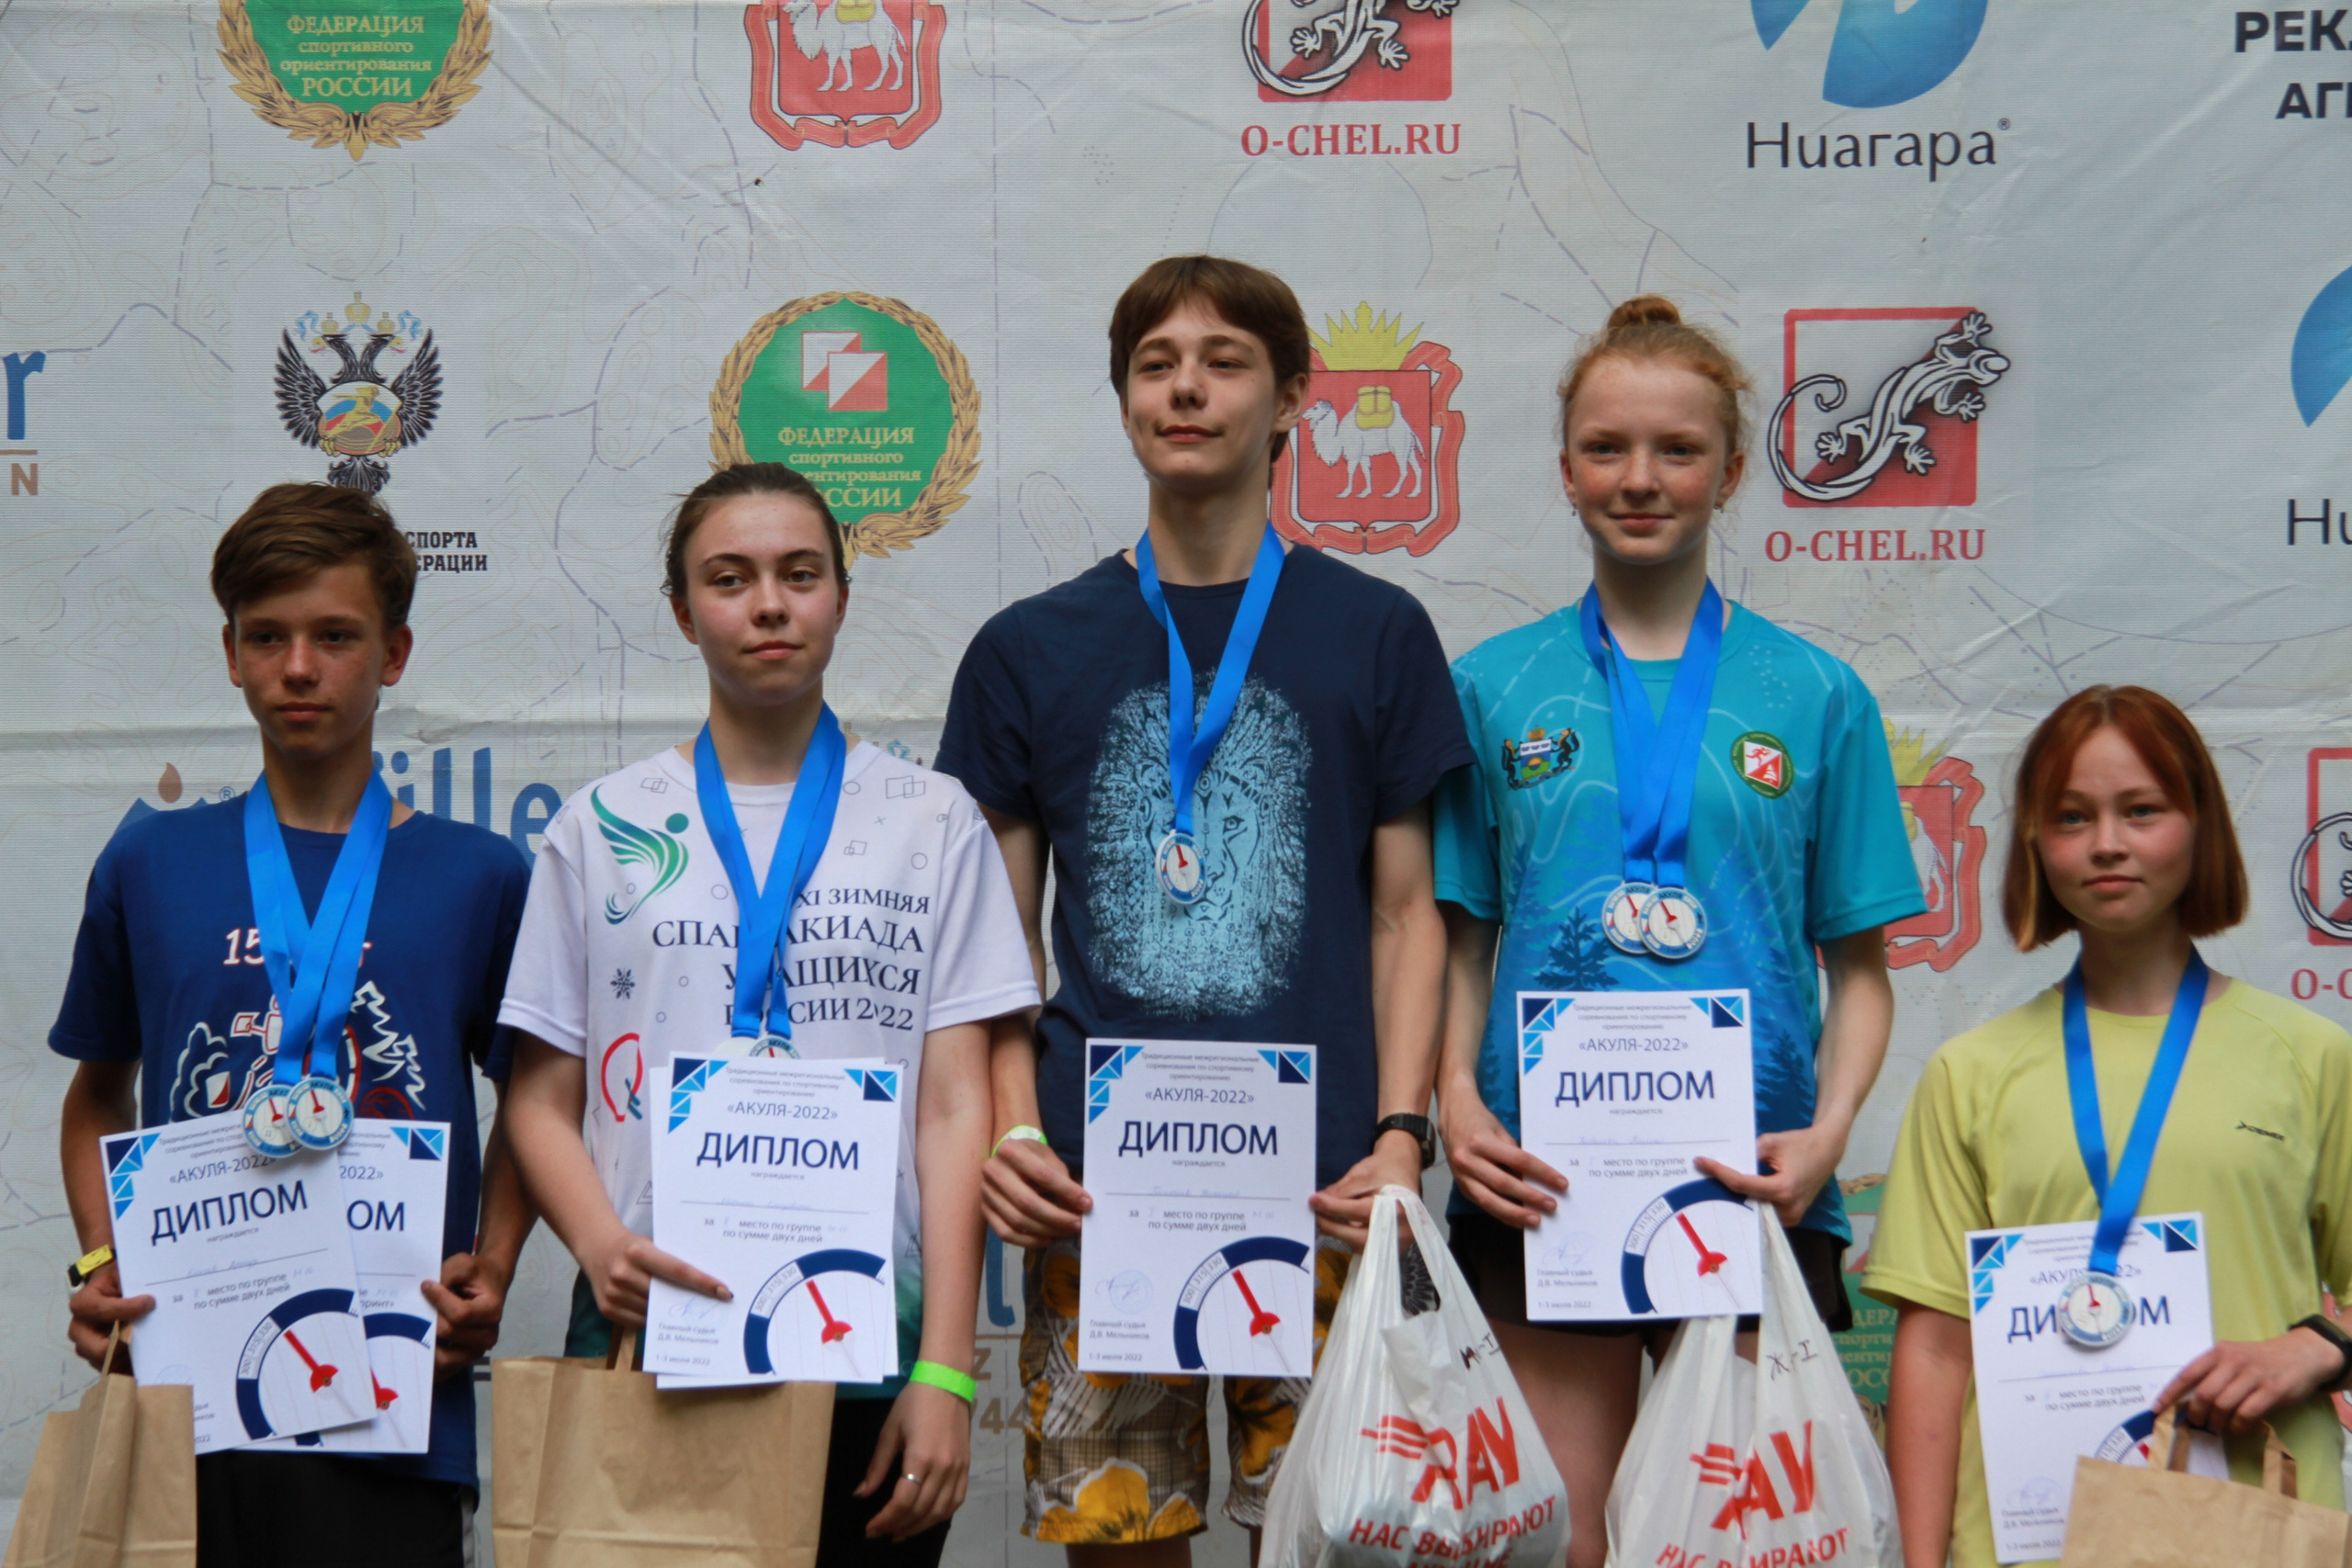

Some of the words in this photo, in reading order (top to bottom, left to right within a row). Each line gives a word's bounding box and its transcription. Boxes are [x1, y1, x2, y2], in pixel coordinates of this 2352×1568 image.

[287, 15, 424, 38] ФЕДЕРАЦИЯ
[2234, 9, 2352, 52] РЕК
[299, 41, 413, 57] спортивного
[279, 60, 432, 75] ориентирования
[301, 77, 413, 96] РОССИИ
[1241, 123, 1461, 156] O-CHEL.RU
[778, 427, 915, 448] ФЕДЕРАЦИЯ
[788, 453, 904, 468] спортивного
[802, 470, 922, 486] ентирования
[817, 488, 901, 507] ССИИ
[404, 531, 478, 548] СПОРТА
[1765, 528, 1985, 561] O-CHEL.RU
[828, 887, 930, 914] ЗИМНЯЯ
[652, 915, 924, 954] СПАКИАДА
[721, 956, 922, 995] ЩИХСЯ
[1578, 1037, 1689, 1052] «АКУЛЯ-2022»
[1146, 1088, 1254, 1104] «АКУЛЯ-2022»
[1555, 1069, 1715, 1108] ДИПЛОМ
[727, 1100, 838, 1121] «АКУЛЯ-2022»
[1118, 1121, 1277, 1158] ДИПЛОМ
[696, 1133, 859, 1170] ДИПЛОМ
[1569, 1158, 1579, 1167] за
[1603, 1158, 1633, 1167] место
[1649, 1157, 1685, 1168] группе
[1589, 1169, 1601, 1178] по
[1603, 1169, 1635, 1179] сумме
[1637, 1168, 1660, 1178] двух
[1662, 1167, 1688, 1177] дней
[151, 1179, 308, 1247] ДИПЛОМ
[346, 1200, 405, 1233] ОМ
[1210, 1213, 1245, 1223] группе
[722, 1230, 736, 1238] по
[738, 1232, 770, 1242] сумме
[772, 1234, 796, 1244] двух
[797, 1234, 822, 1244] дней
[739, 1220, 769, 1229] место
[786, 1224, 821, 1234] группе
[1163, 1223, 1194, 1233] сумме
[1196, 1223, 1219, 1232] двух
[1221, 1223, 1246, 1232] дней
[172, 1295, 184, 1303] за
[207, 1284, 236, 1297] место
[238, 1281, 251, 1292] по
[253, 1272, 288, 1290] группе
[194, 1300, 207, 1311] по
[209, 1294, 240, 1309] сумме
[241, 1288, 265, 1302] двух
[266, 1282, 291, 1296] дней
[2059, 1388, 2089, 1399] место
[2091, 1388, 2105, 1397] по
[2106, 1383, 2142, 1397] группе
[2045, 1403, 2058, 1412] по
[2060, 1400, 2093, 1411] сумме
[2095, 1397, 2118, 1408] двух
[2120, 1393, 2145, 1405] дней
[1348, 1517, 1409, 1551] НАС
